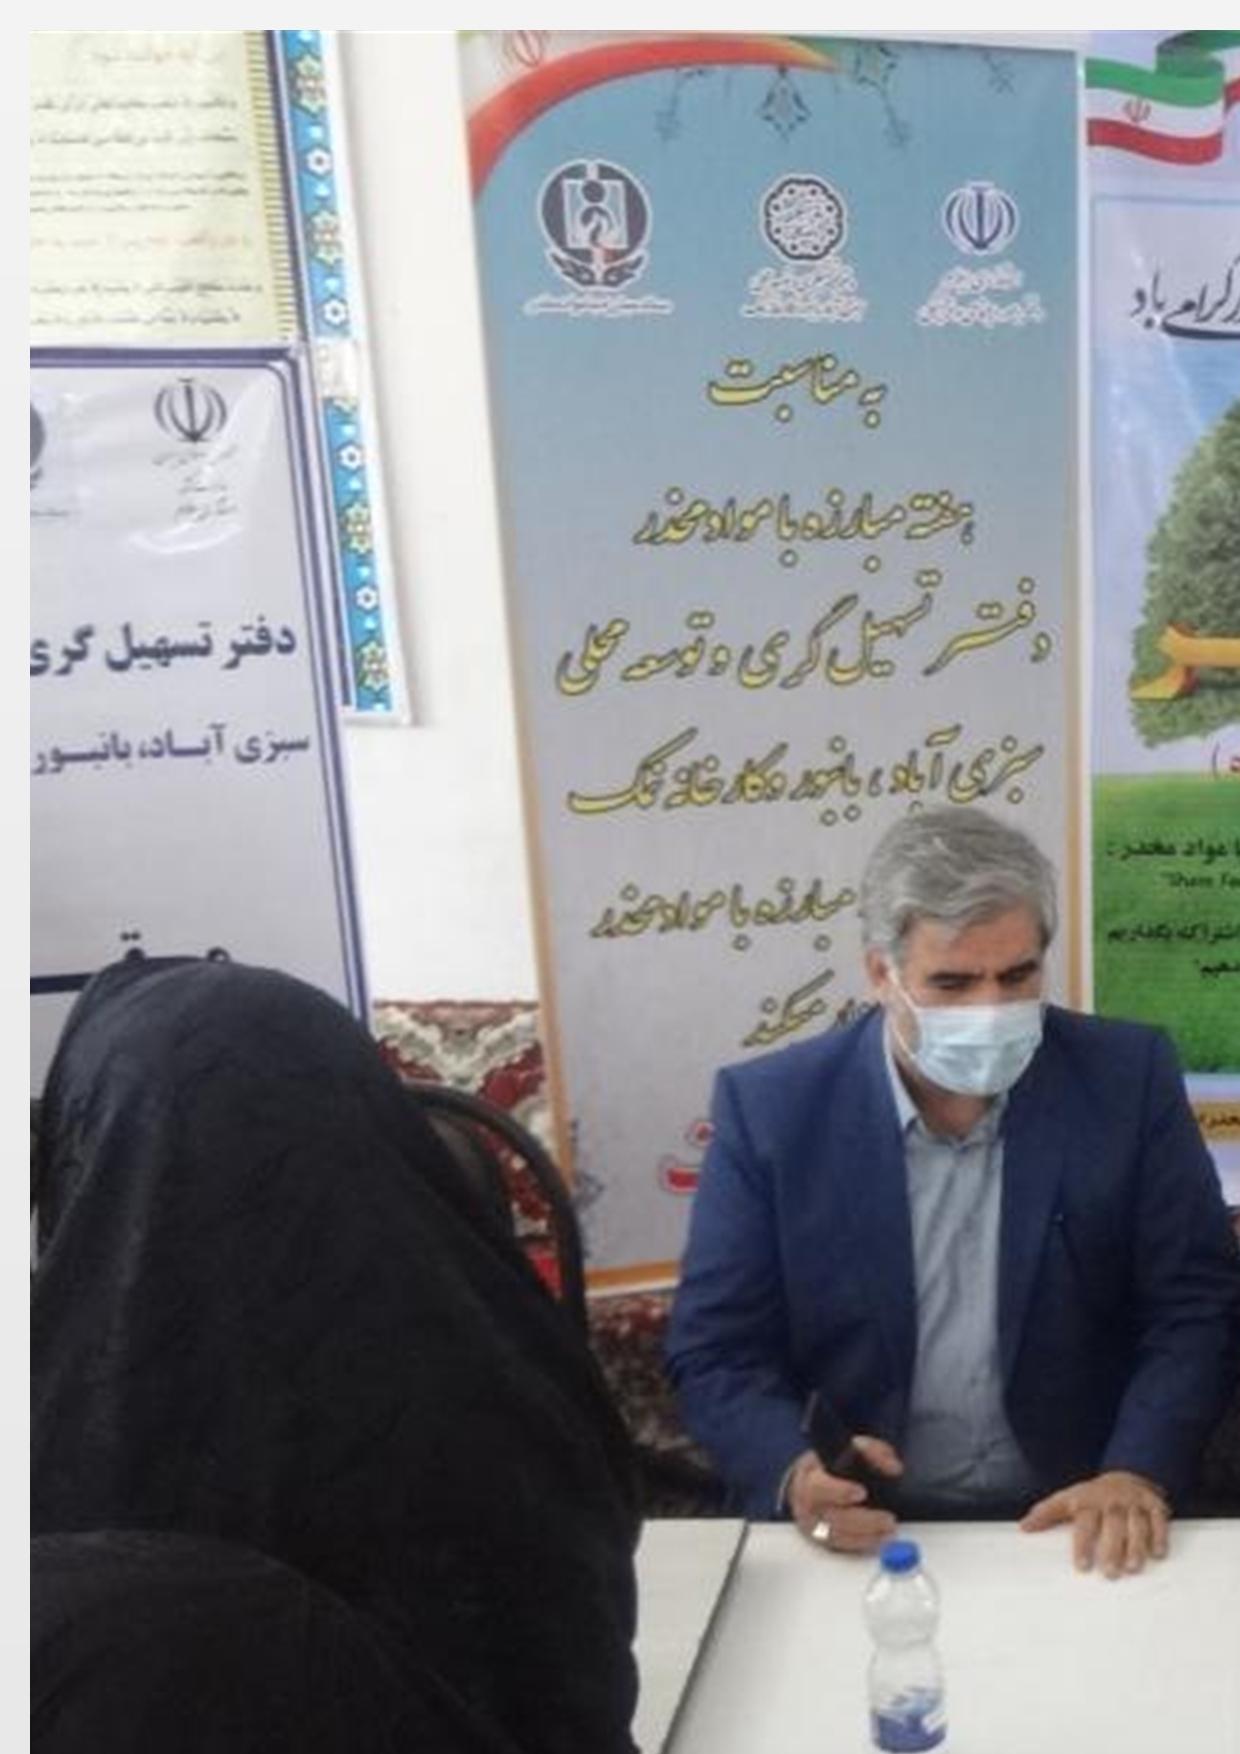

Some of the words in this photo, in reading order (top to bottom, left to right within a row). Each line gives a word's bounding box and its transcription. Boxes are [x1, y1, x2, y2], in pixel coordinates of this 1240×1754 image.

[1128, 268, 1165, 330] باد
[707, 350, 860, 423] مناسبت
[858, 380, 889, 428] به
[633, 486, 711, 546] مخدر
[702, 496, 774, 543] مواد
[776, 492, 799, 569] با
[800, 487, 907, 574] مبارزه
[904, 489, 975, 546] هفته
[104, 620, 214, 673] تسهیل
[221, 614, 297, 671] دفتر
[555, 617, 631, 697] محلی
[620, 609, 716, 683] توسعه
[738, 593, 860, 690] گری
[825, 568, 942, 686] تسهیل
[923, 575, 1053, 677] دفتر
[705, 643, 732, 677] و
[233, 728, 310, 764] سبزی
[946, 733, 1046, 805] سبزی
[590, 882, 667, 939] مخدر
[657, 889, 728, 934] مواد
[730, 883, 753, 952] با
[753, 876, 858, 952] مبارزه
